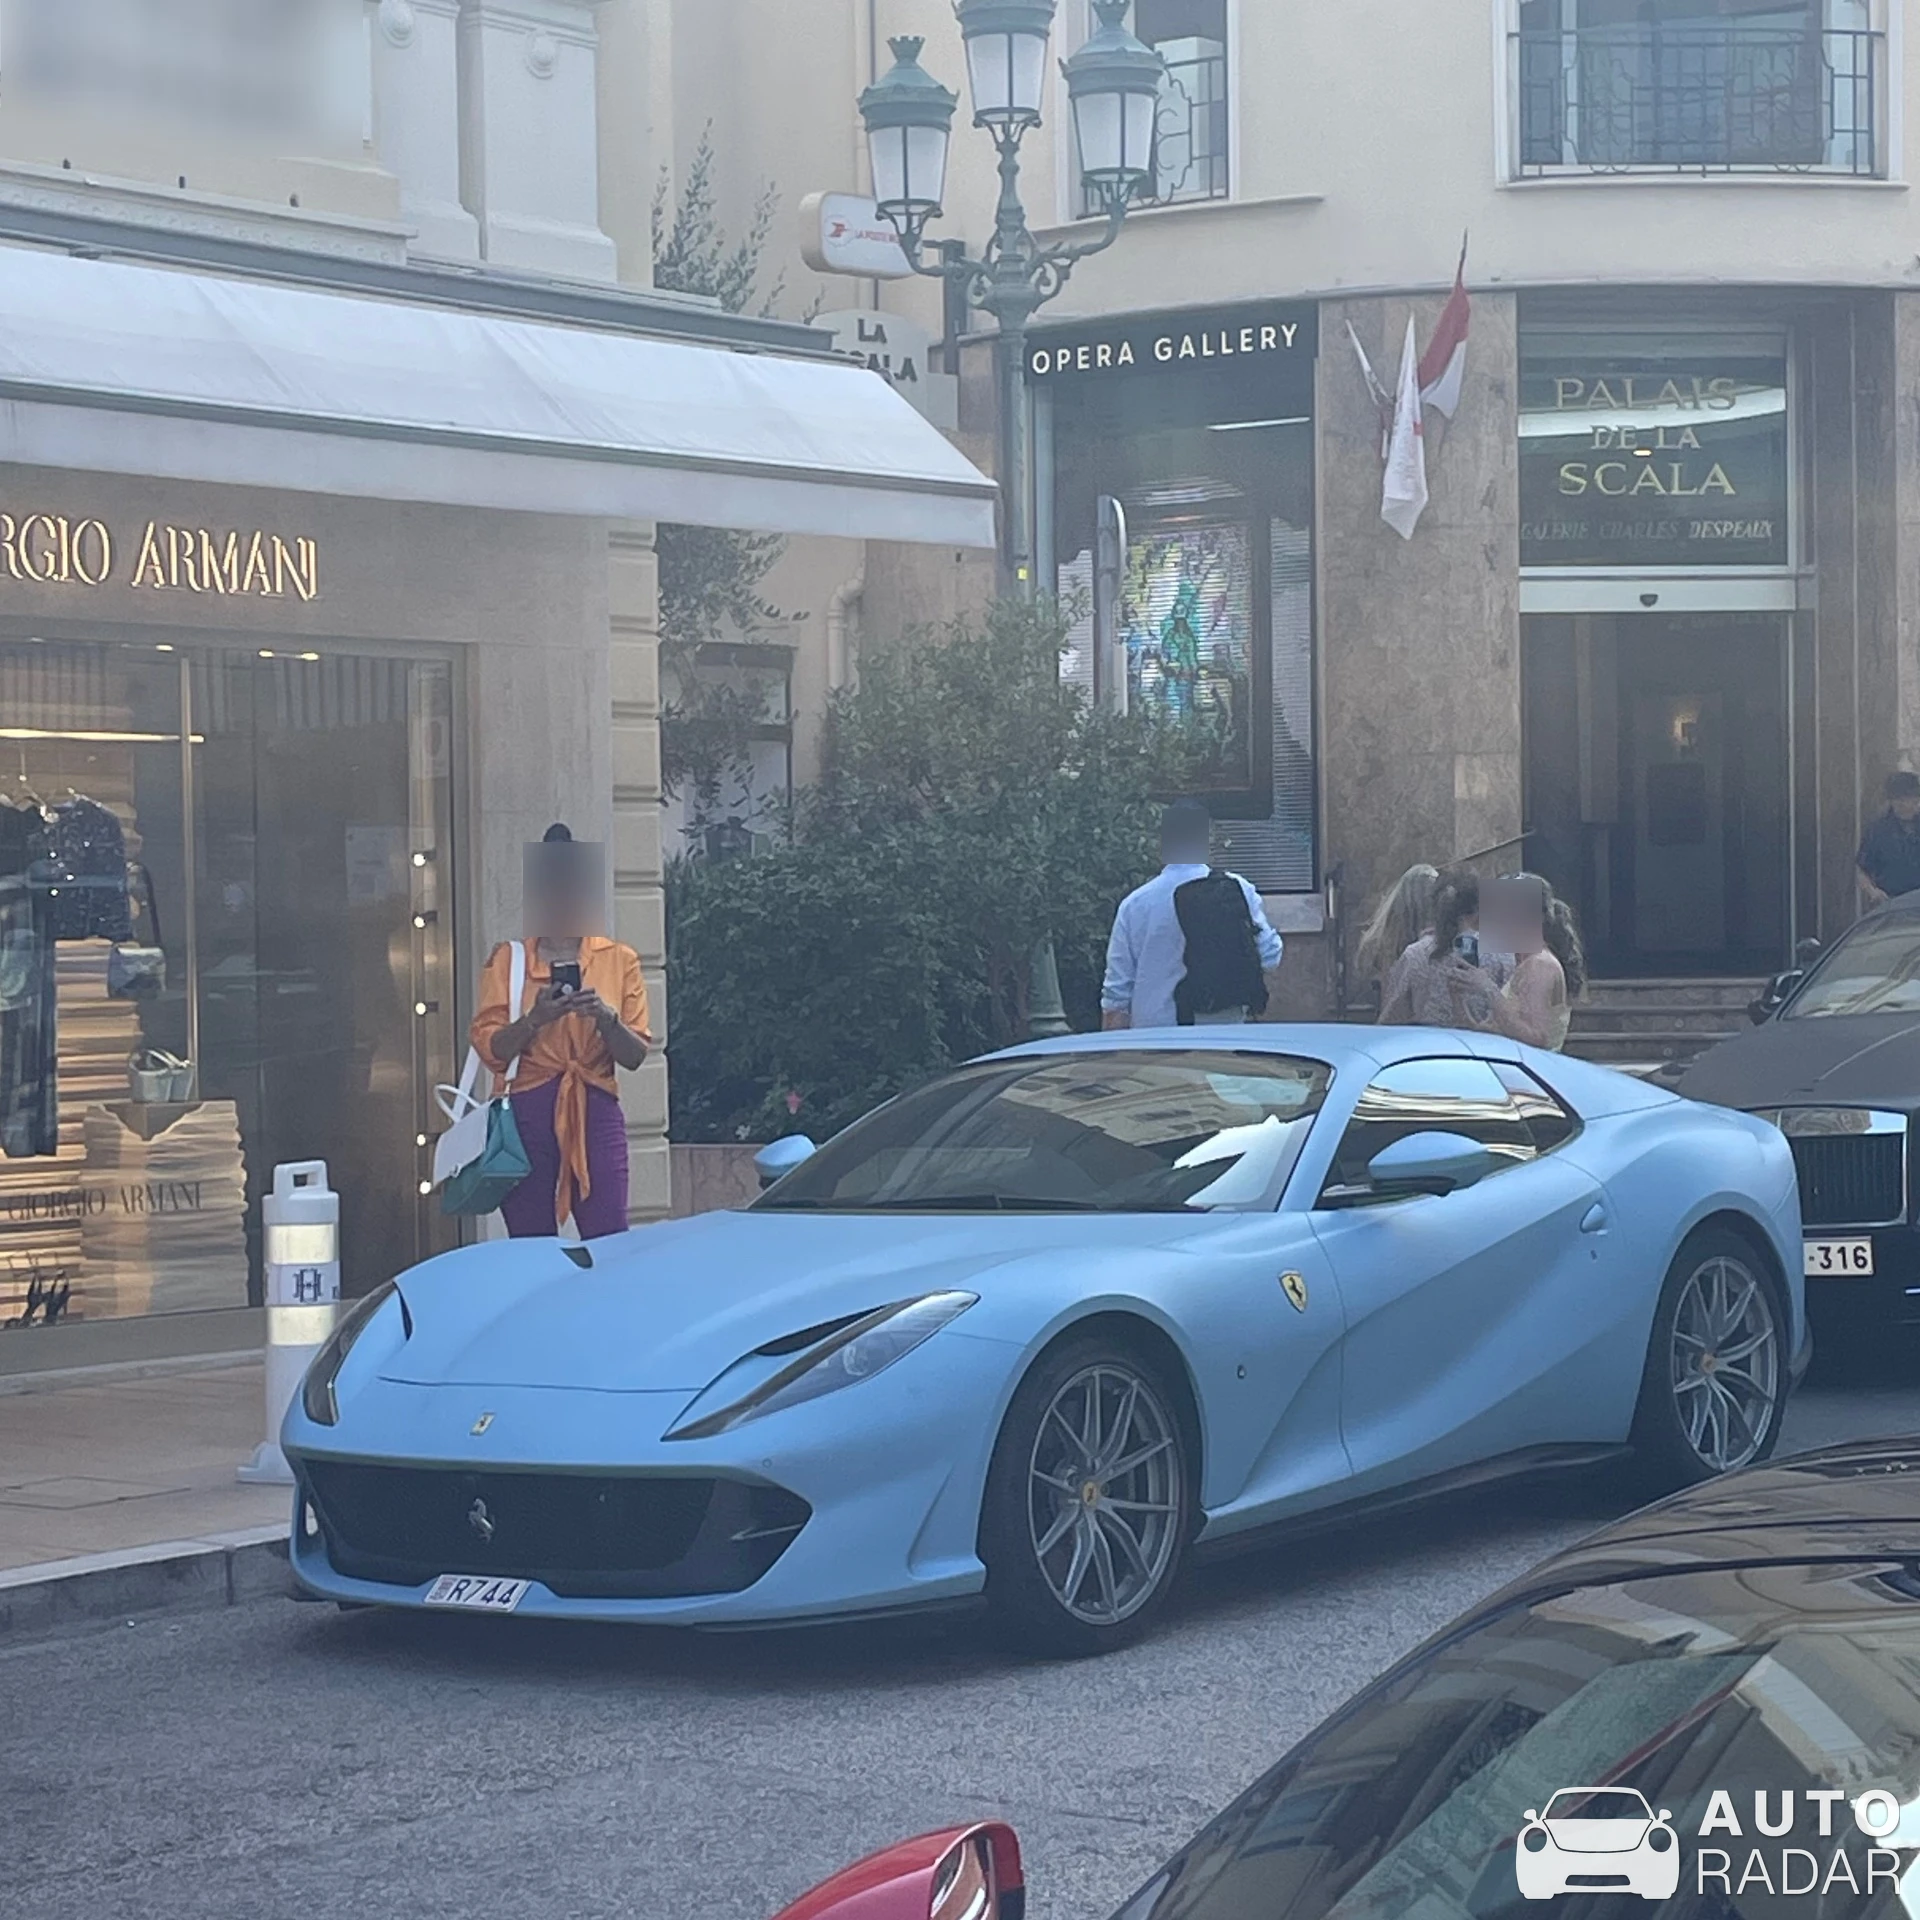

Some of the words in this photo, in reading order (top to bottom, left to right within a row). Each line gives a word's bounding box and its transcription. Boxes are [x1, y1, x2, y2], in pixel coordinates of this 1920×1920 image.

[858, 318, 887, 344] LA
[1032, 341, 1134, 374] OPERA
[1154, 323, 1298, 362] GALLERY
[1553, 377, 1737, 411] PALAIS
[1590, 424, 1638, 449] DE
[1655, 425, 1702, 450] LA
[1558, 462, 1736, 496] SCALA
[1600, 520, 1681, 540] CHARLES
[130, 521, 318, 602] ARMANI
[8, 1187, 107, 1221] GIORGIO
[119, 1181, 202, 1215] ARMANI
[446, 1579, 520, 1605] R744
